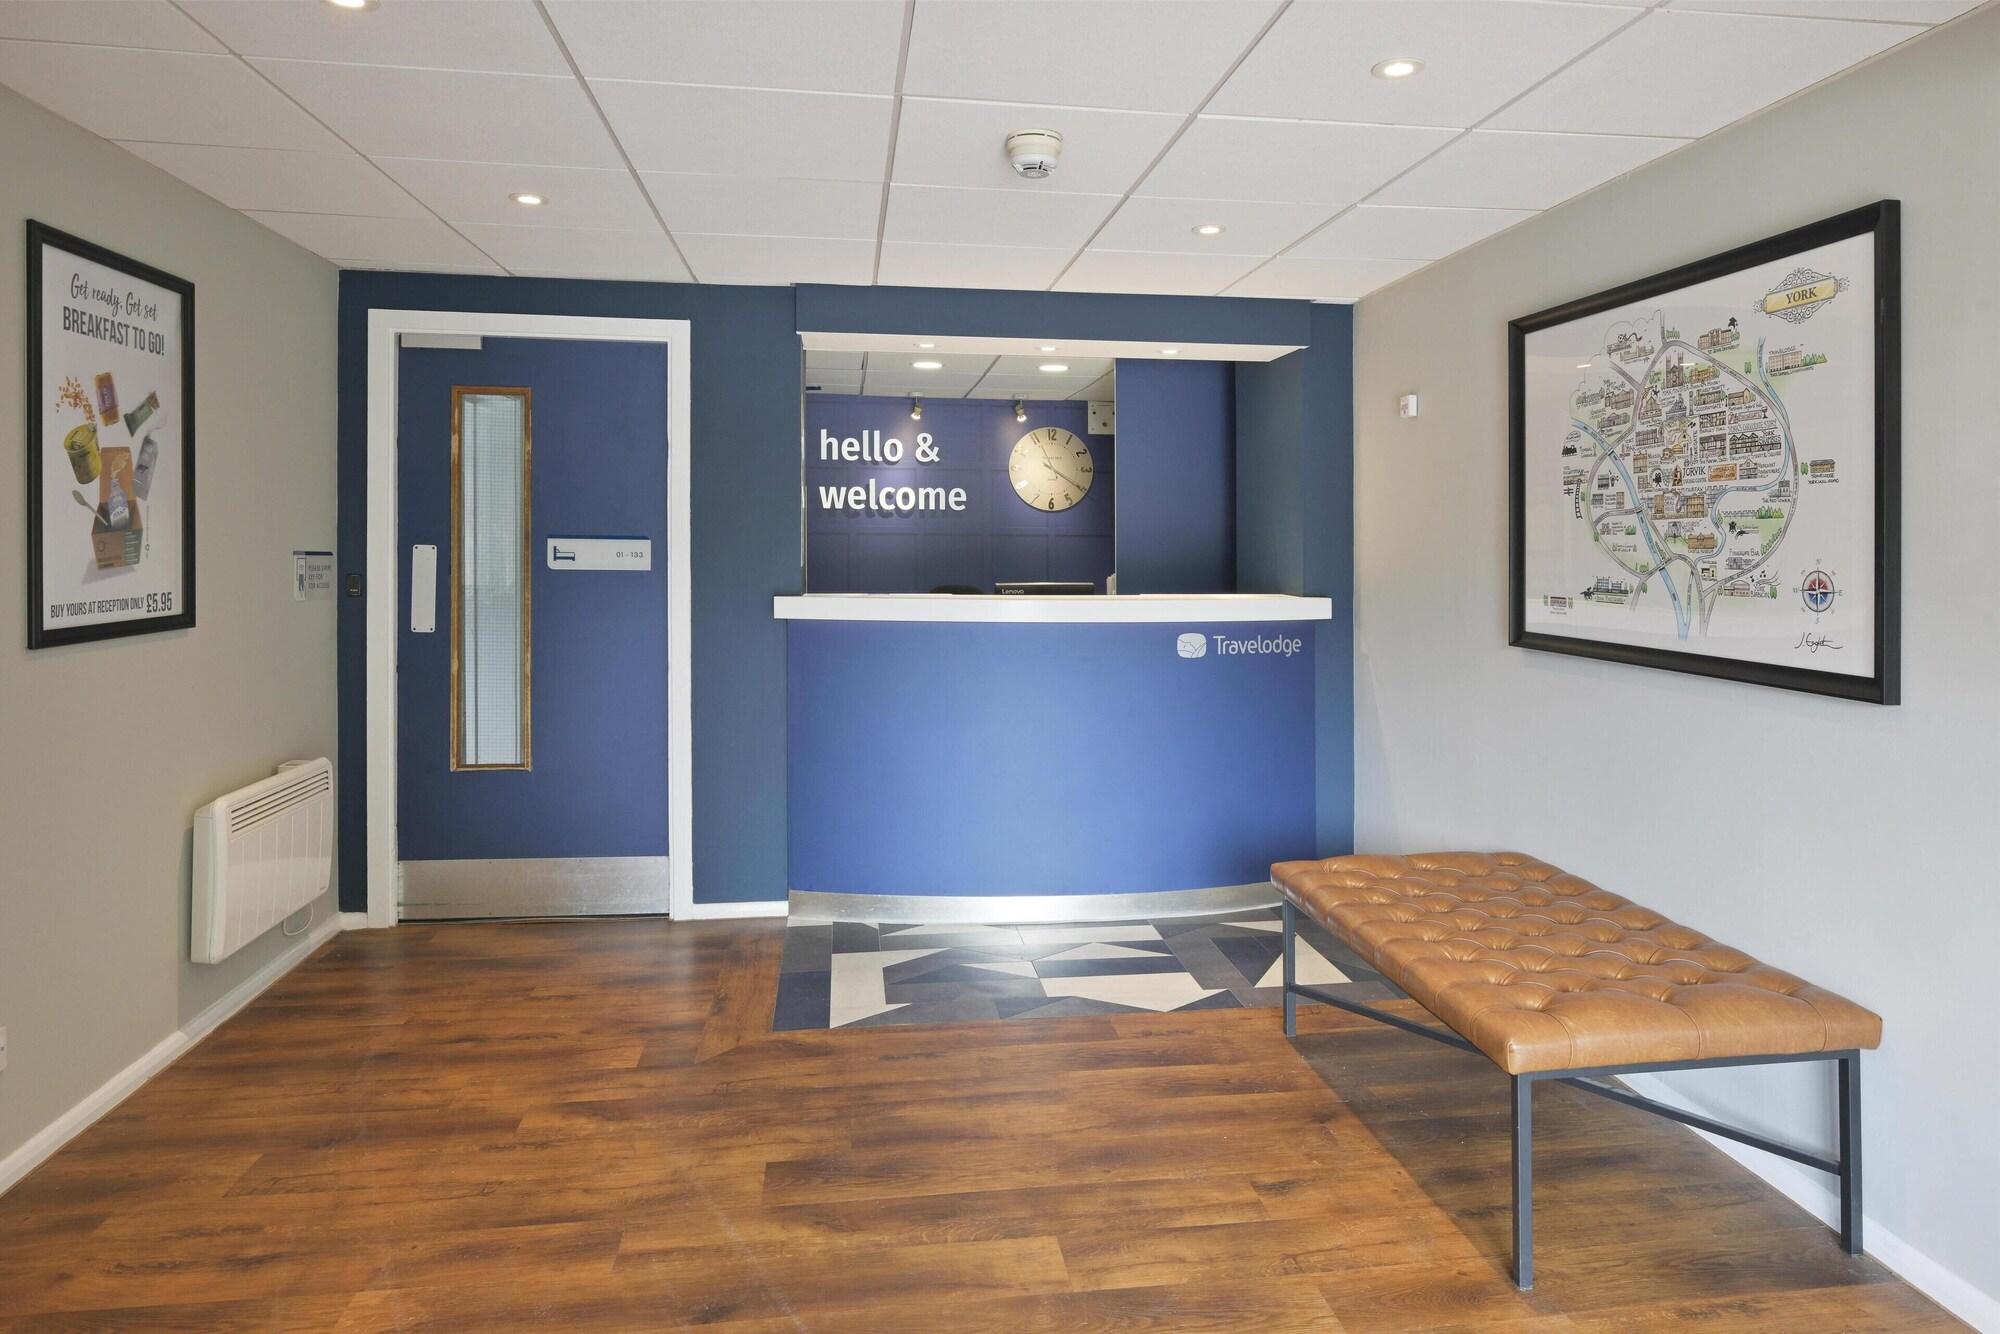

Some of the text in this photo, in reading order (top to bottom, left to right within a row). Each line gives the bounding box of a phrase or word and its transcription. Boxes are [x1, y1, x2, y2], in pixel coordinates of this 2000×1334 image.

[70, 272, 89, 300] Get
[126, 291, 142, 317] Get
[144, 303, 157, 321] set
[1785, 286, 1818, 305] YORK
[63, 306, 165, 356] BREAKFAST TO GO!
[1047, 428, 1057, 441] 12
[820, 428, 940, 463] hello &
[1075, 448, 1088, 458] 2
[1682, 465, 1706, 479] JORVIK
[818, 478, 967, 511] welcome
[1048, 497, 1055, 510] 6
[1064, 493, 1073, 506] 5
[630, 551, 644, 559] 133
[50, 591, 173, 619] BUY YOURS AT RECEPTION ONLY £5.95
[1213, 634, 1302, 657] Travelodge
